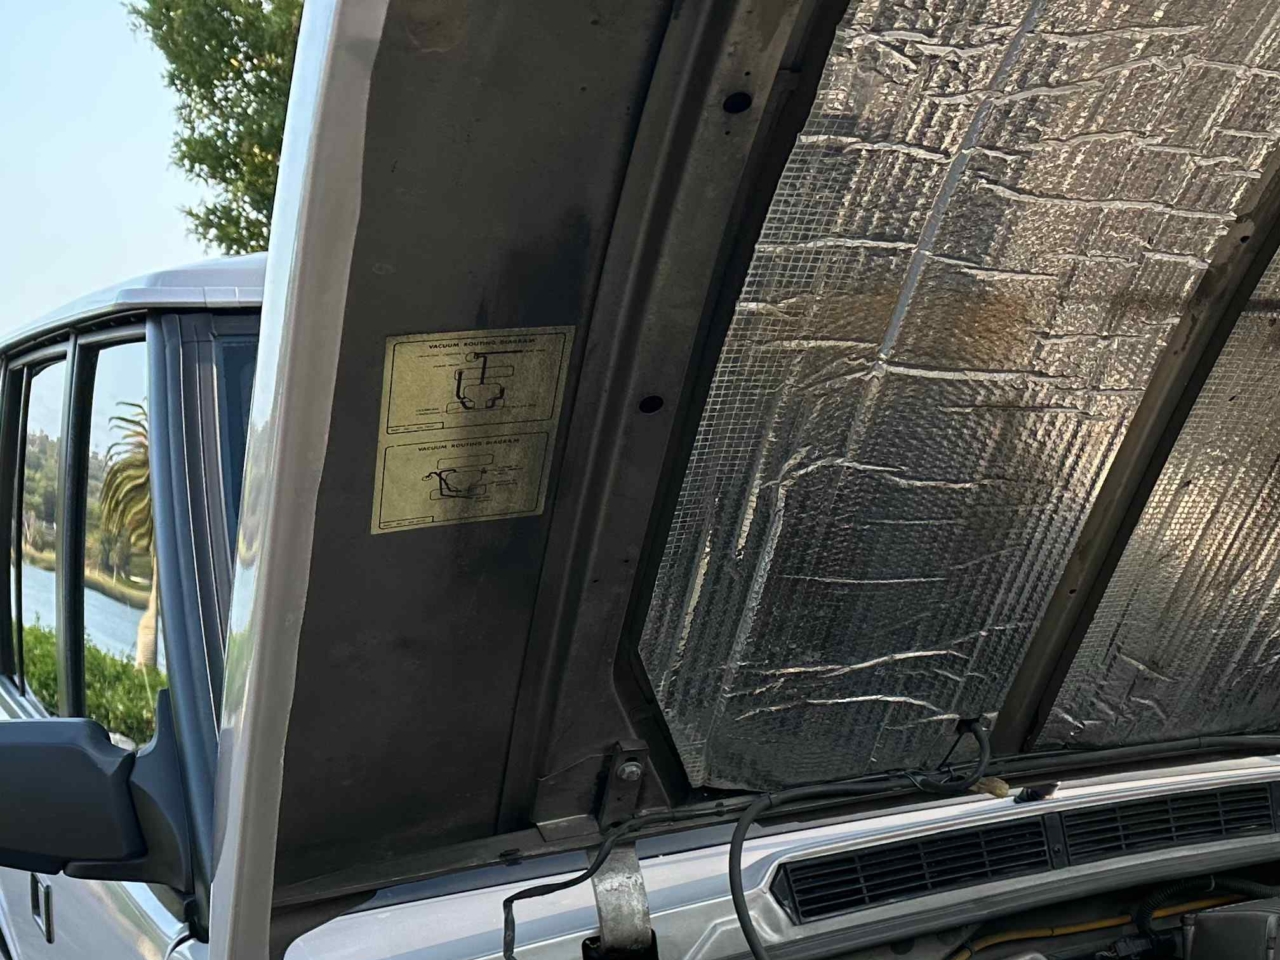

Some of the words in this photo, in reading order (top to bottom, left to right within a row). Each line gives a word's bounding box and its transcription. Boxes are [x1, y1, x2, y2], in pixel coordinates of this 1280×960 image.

[428, 341, 459, 349] VACUUM
[462, 339, 496, 347] ROUTING
[499, 337, 536, 345] DIAGRAM
[417, 443, 447, 452] VACUUM
[450, 440, 482, 449] ROUTING
[485, 437, 520, 446] DIAGRAM
